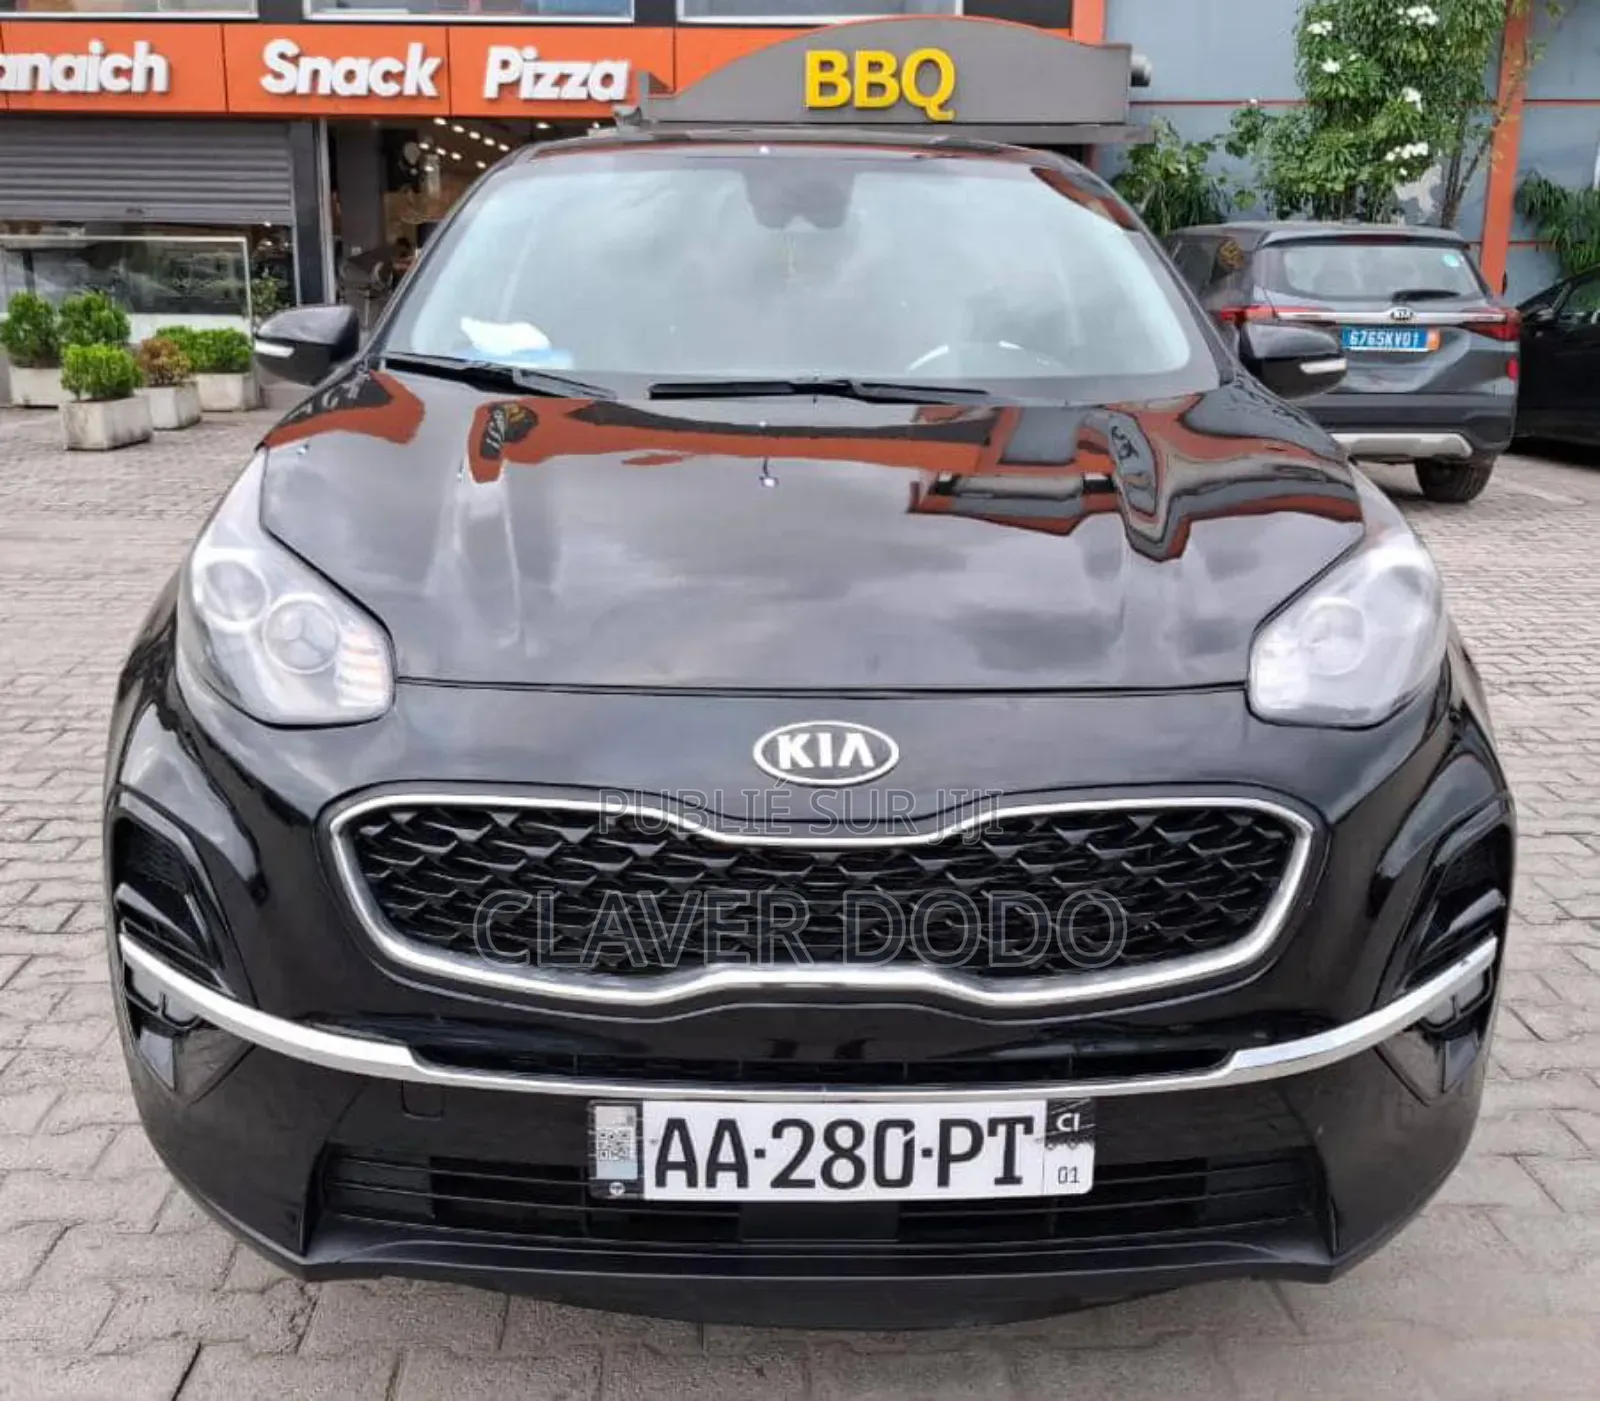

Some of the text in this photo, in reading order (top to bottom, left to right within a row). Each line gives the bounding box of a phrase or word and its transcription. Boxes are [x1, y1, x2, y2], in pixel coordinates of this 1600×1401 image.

[259, 38, 441, 97] Snack
[483, 46, 629, 100] Pizza
[805, 48, 956, 121] BBQ
[776, 732, 875, 769] KIA
[1056, 1112, 1080, 1132] CI
[1057, 1165, 1080, 1185] 01
